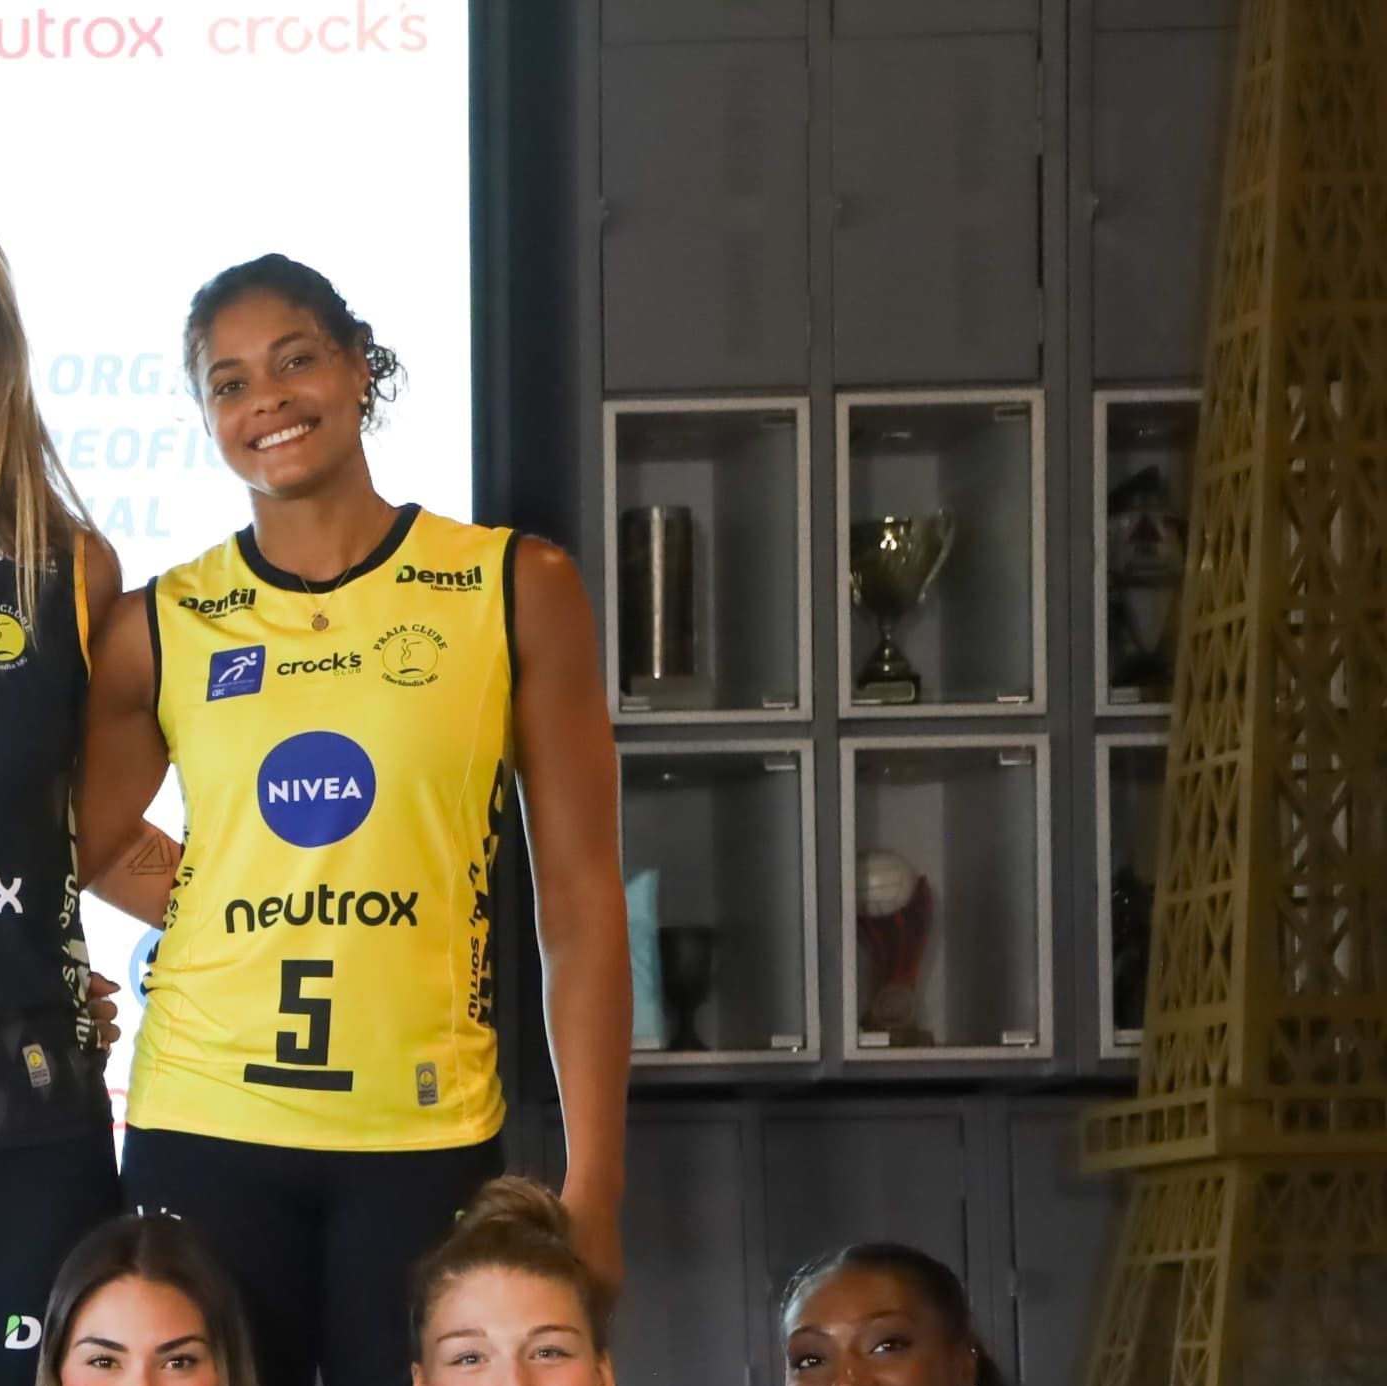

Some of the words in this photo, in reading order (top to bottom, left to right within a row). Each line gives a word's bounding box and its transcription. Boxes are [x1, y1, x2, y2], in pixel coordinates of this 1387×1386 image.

[395, 564, 483, 587] Dentil
[178, 588, 257, 616] Dentil
[373, 623, 408, 652] PRAIA
[411, 623, 449, 652] CLUBE
[277, 651, 362, 676] crock's
[268, 775, 363, 804] NIVEA
[225, 884, 419, 934] neutrox
[275, 960, 335, 1067] 5
